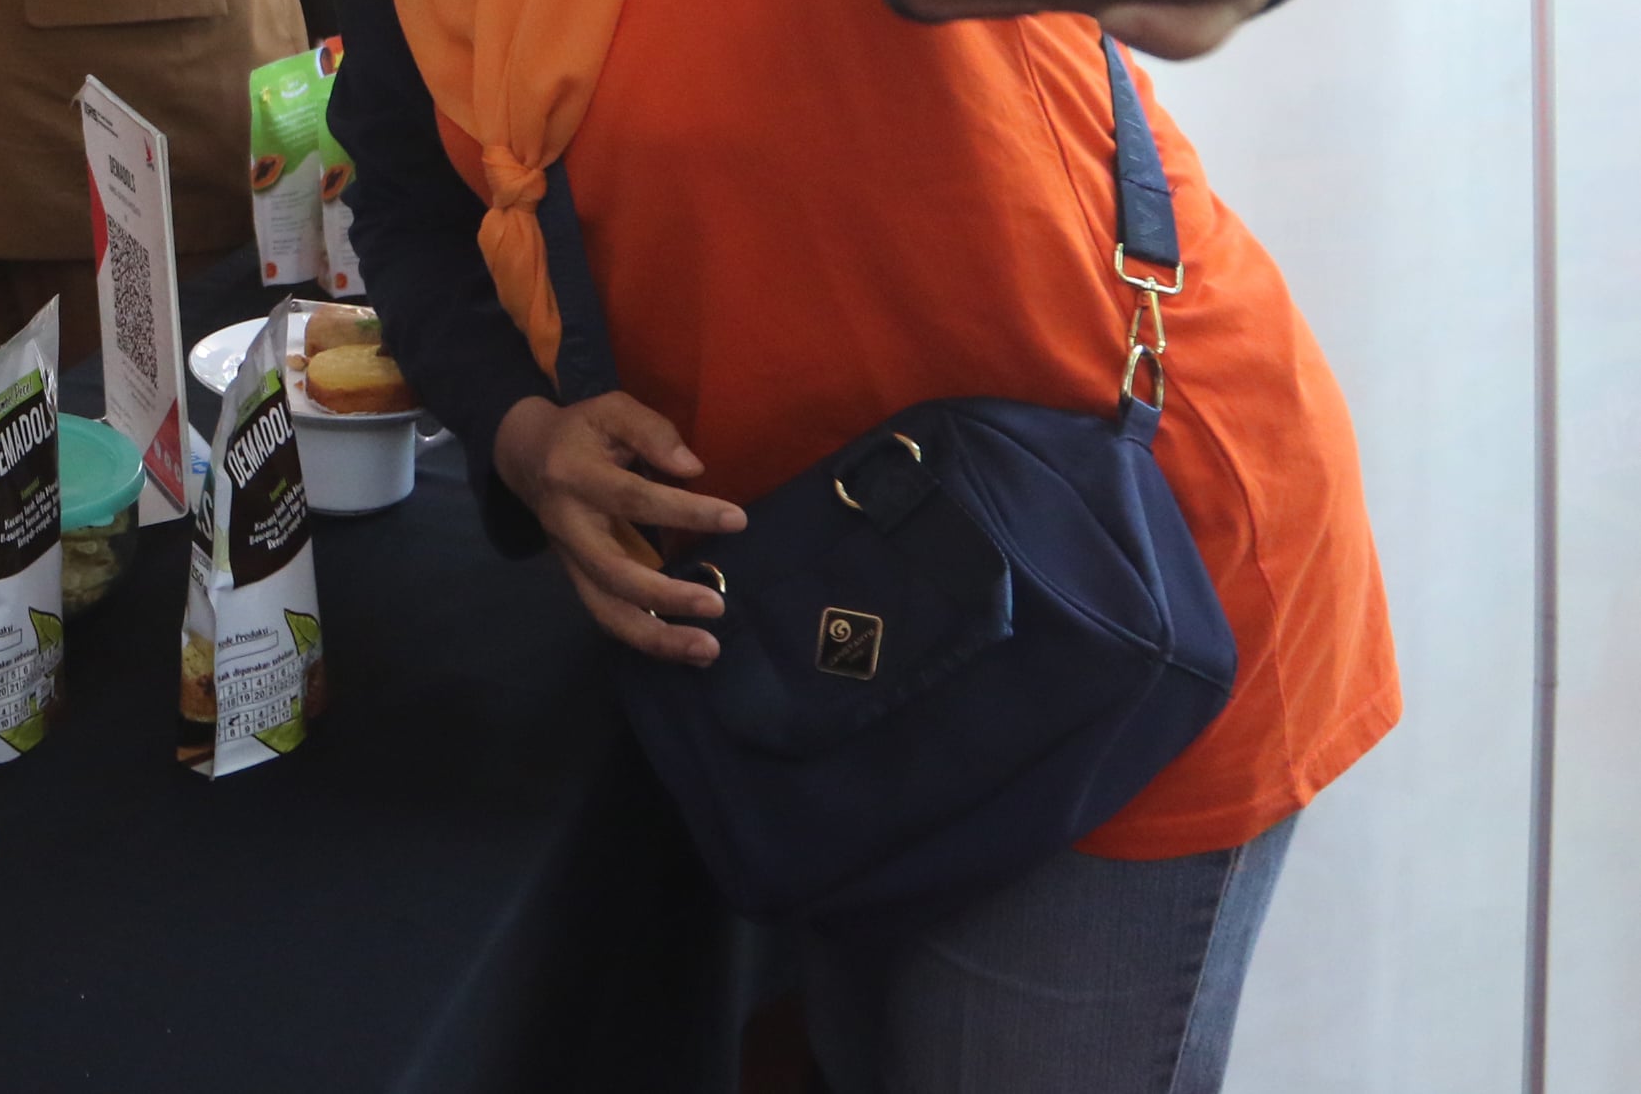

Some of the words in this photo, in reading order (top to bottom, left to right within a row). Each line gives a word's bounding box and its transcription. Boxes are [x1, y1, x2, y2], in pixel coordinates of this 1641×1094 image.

[227, 400, 295, 490] DEMADOL
[10, 681, 20, 693] 21
[240, 693, 251, 704] 19
[254, 689, 265, 700] 20
